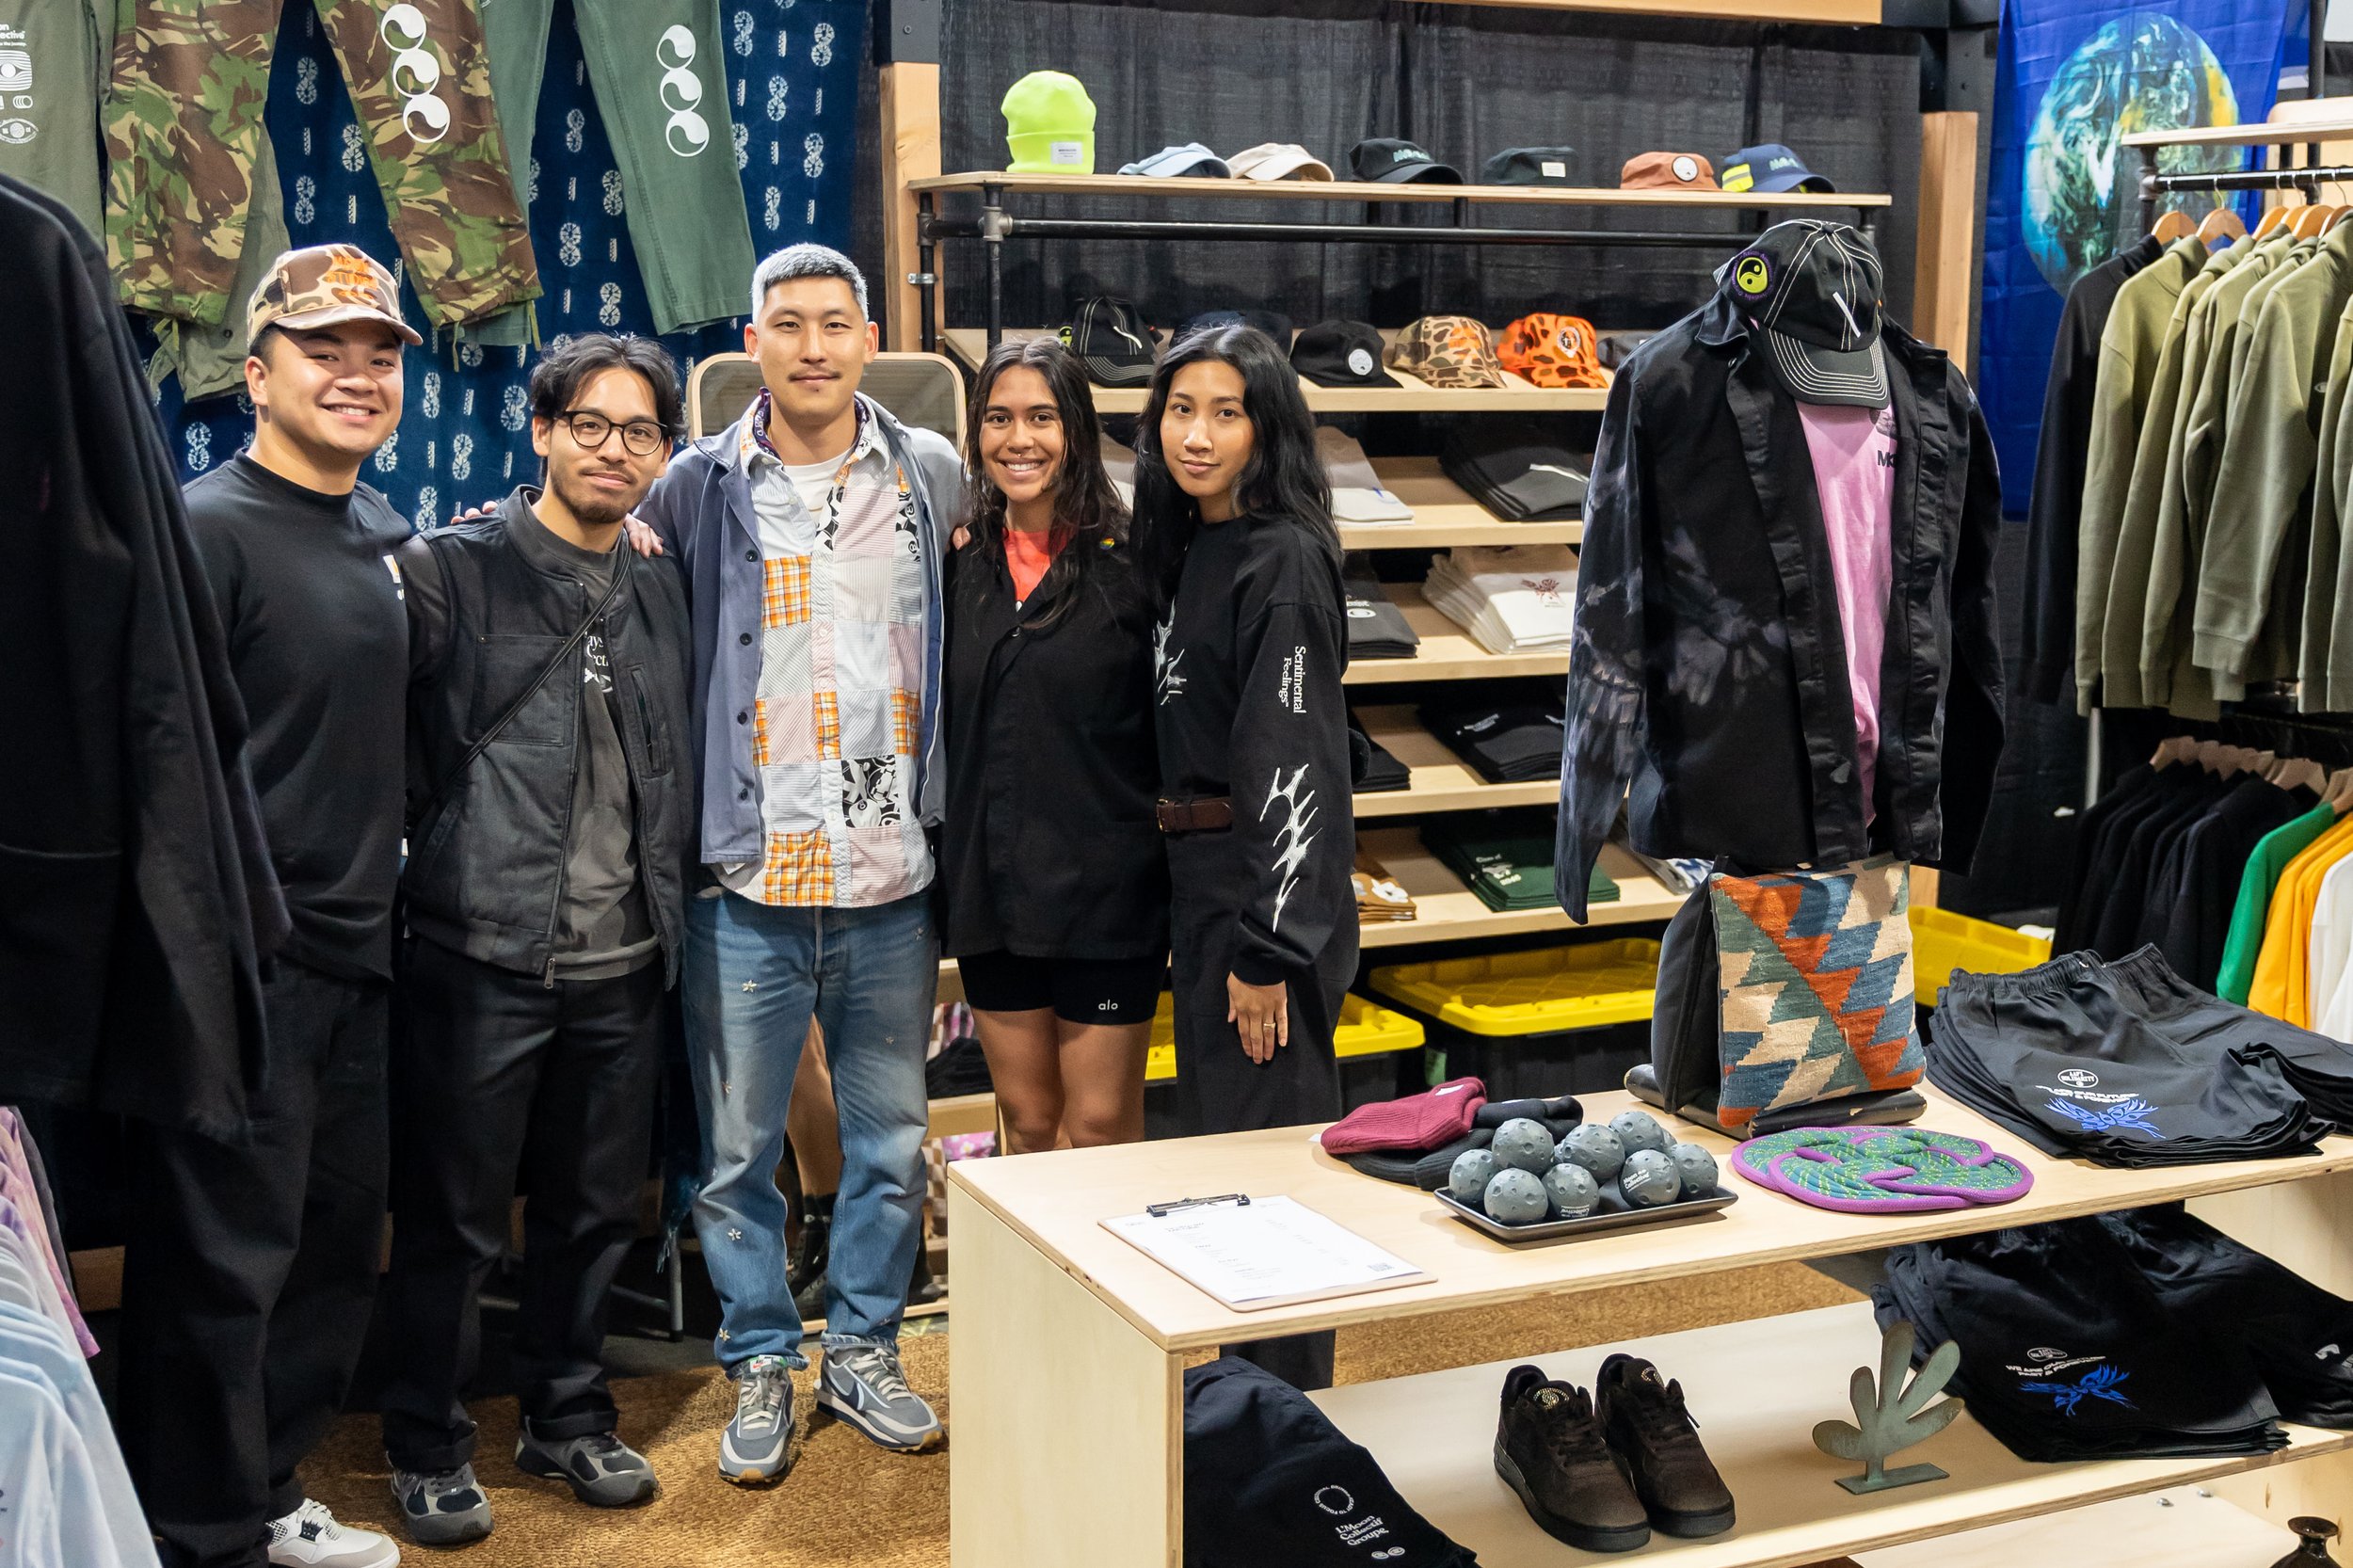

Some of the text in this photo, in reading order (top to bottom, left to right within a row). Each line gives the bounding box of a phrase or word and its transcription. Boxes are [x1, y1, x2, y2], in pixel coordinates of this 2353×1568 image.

[1293, 646, 1306, 712] Sentimental
[1098, 999, 1118, 1010] alo
[1339, 1517, 1384, 1541] Collectif
